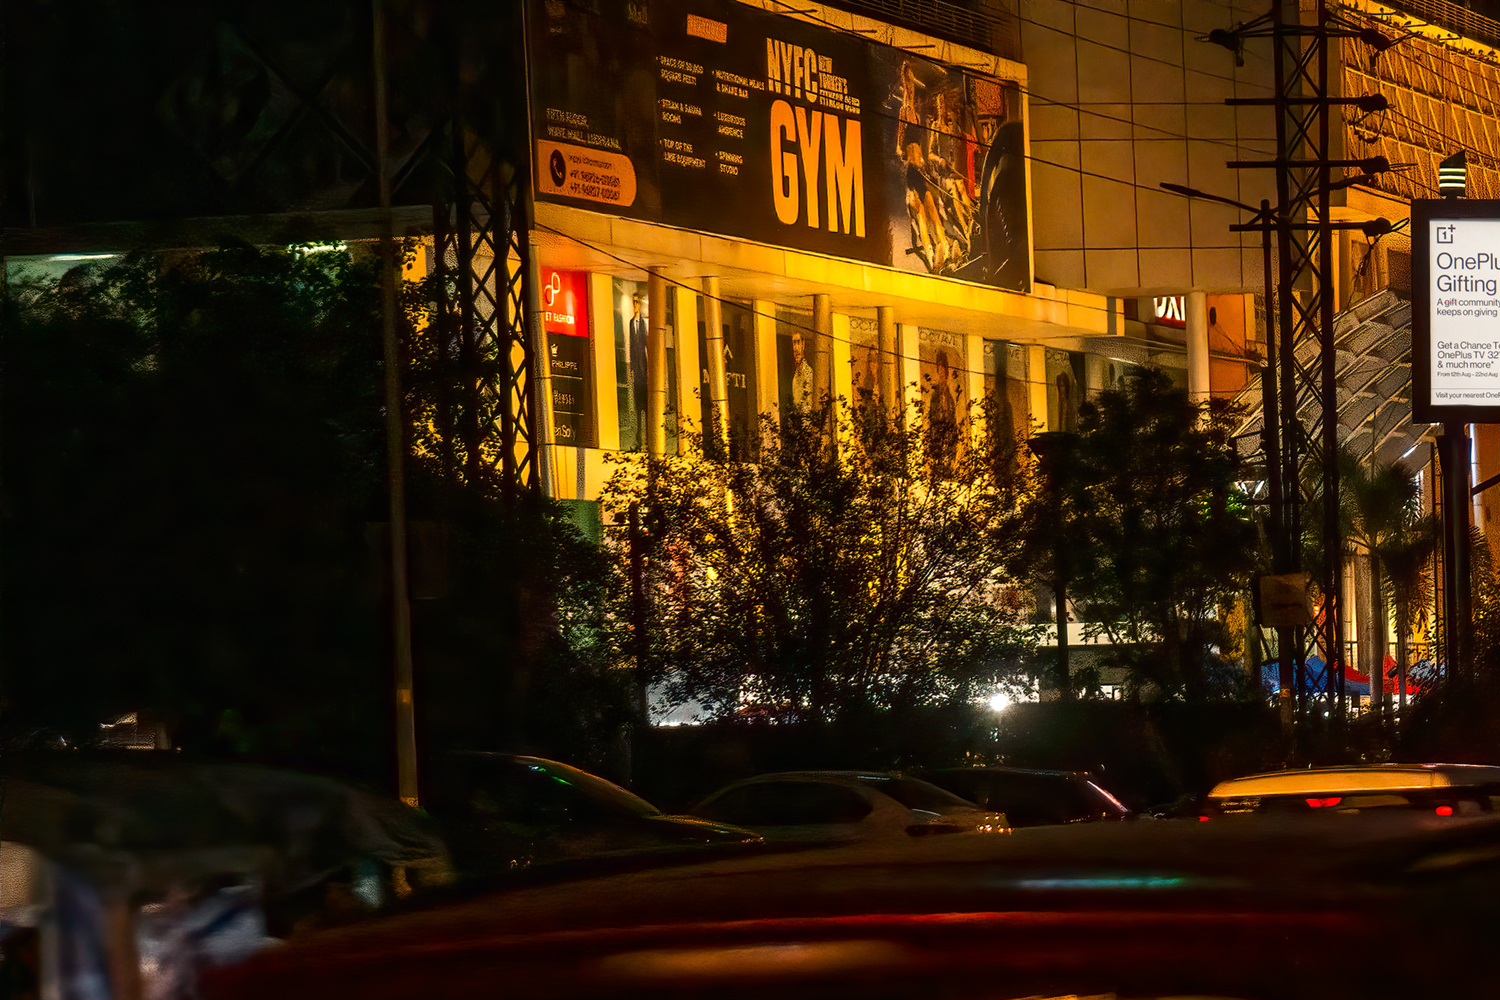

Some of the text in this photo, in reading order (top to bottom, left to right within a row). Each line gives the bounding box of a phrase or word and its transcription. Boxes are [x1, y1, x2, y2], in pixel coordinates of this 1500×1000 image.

[767, 37, 818, 103] NYFC
[770, 99, 866, 237] GYM
[1436, 274, 1497, 296] Gifting
[1436, 298, 1444, 307] A
[1444, 298, 1458, 308] gift
[1436, 308, 1462, 317] keeps
[1474, 308, 1498, 317] giving
[1437, 341, 1453, 350] Get
[1460, 341, 1492, 350] Chance
[1437, 351, 1472, 360] OnePlus
[1473, 351, 1485, 359] TV
[1437, 361, 1443, 369] &
[1446, 361, 1468, 369] much
